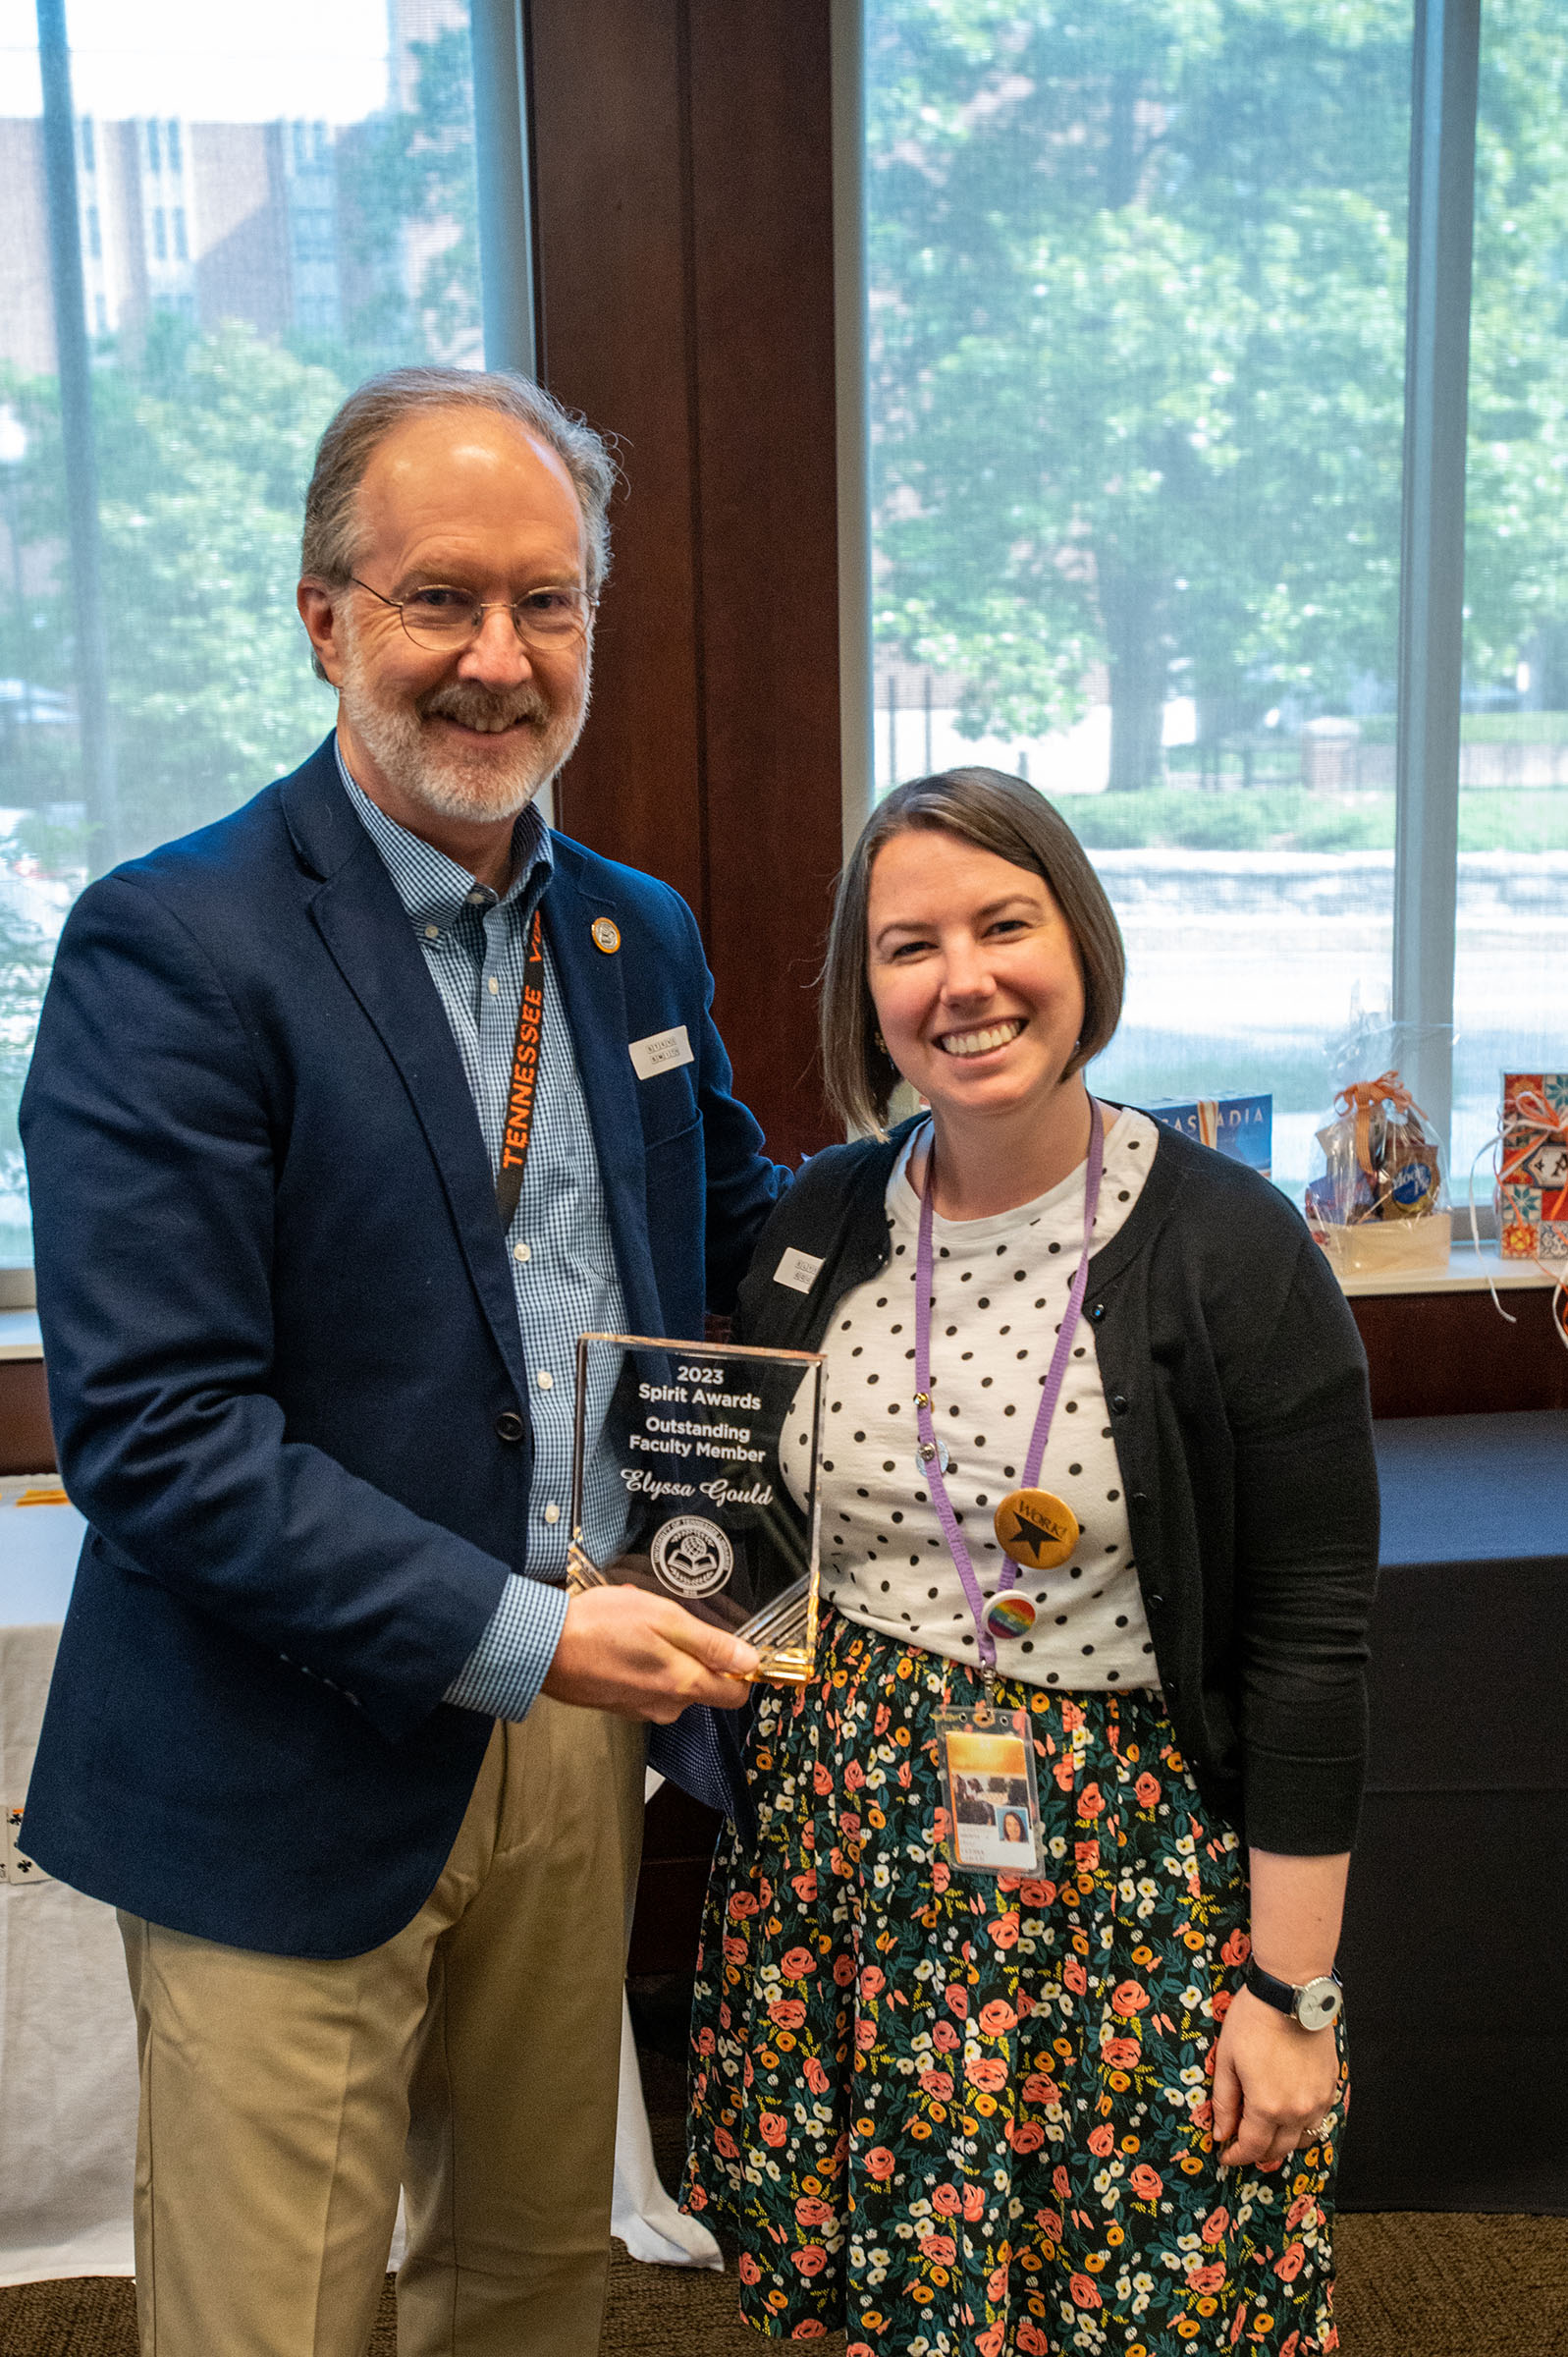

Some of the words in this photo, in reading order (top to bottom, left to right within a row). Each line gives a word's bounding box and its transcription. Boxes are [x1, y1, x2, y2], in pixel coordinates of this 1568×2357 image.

[502, 984, 543, 1169] TENNESSEE
[1162, 1107, 1265, 1133] ASADIA
[676, 1365, 725, 1385] 2023
[638, 1382, 688, 1403] Spirit
[691, 1388, 762, 1410] Awards
[646, 1415, 751, 1444] Outstanding
[628, 1435, 692, 1457] Faculty
[695, 1441, 766, 1463] Member
[620, 1468, 696, 1501] Elyssa
[699, 1478, 774, 1508] Gould
